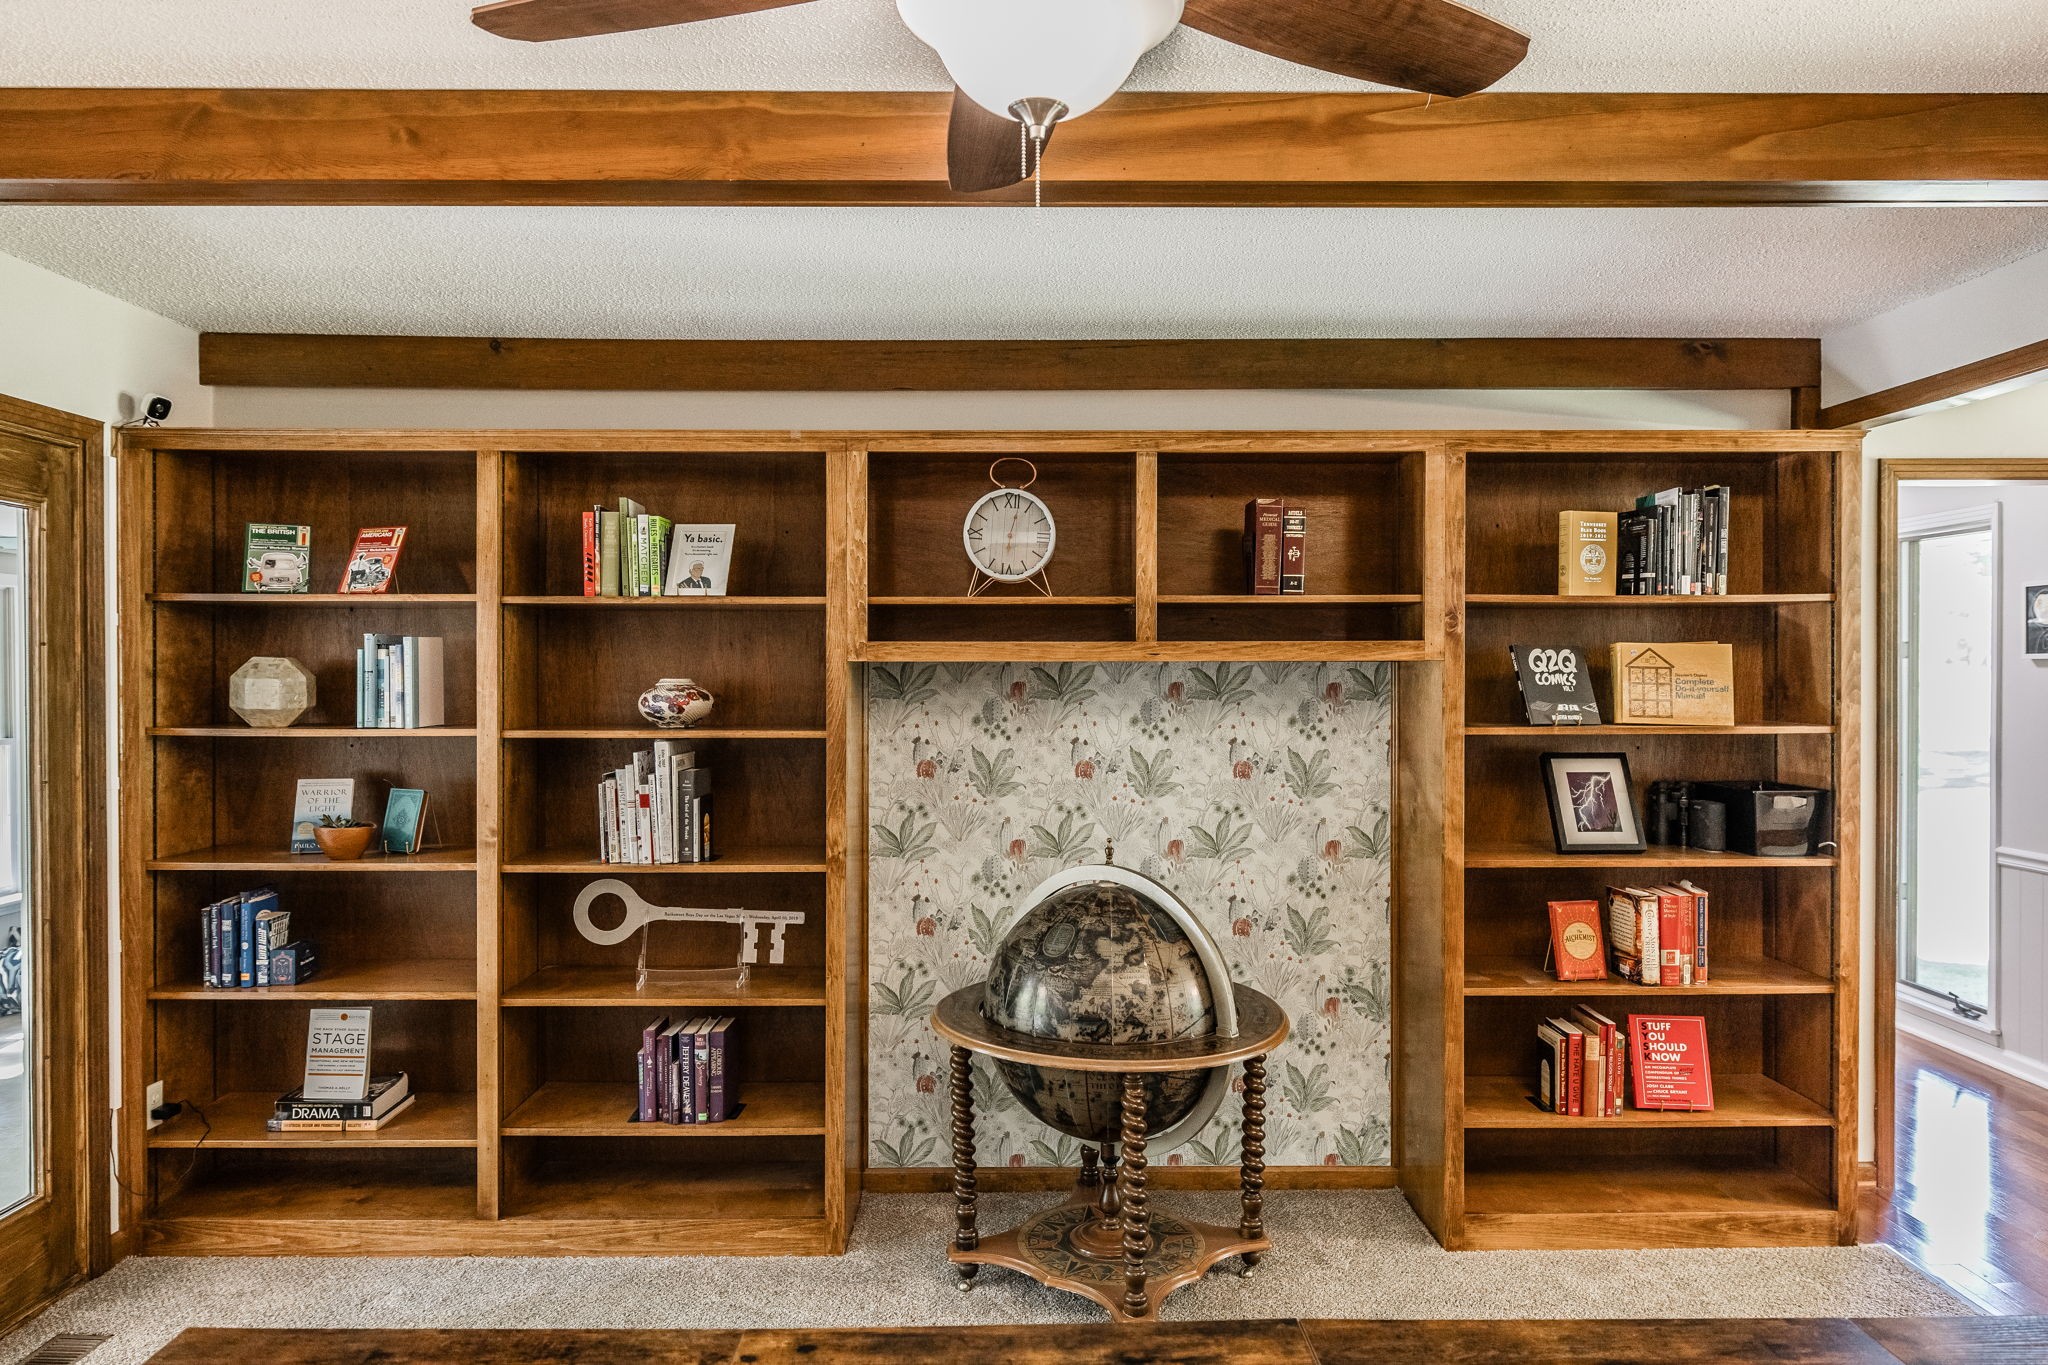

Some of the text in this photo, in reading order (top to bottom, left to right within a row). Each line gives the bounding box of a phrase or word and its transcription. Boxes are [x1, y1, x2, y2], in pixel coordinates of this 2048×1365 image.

[1004, 492, 1020, 509] XII
[684, 533, 723, 543] Ya basic.
[1528, 648, 1577, 673] Q2Q
[1535, 673, 1577, 686] COMICS
[1675, 677, 1715, 686] Complete
[1675, 685, 1729, 693] Do-it-yourself
[301, 788, 348, 796] WARRIOR
[323, 796, 341, 804] THE
[309, 805, 336, 813] LIGHT
[1564, 934, 1595, 943] ALCHEMIST
[1641, 1022, 1671, 1031] STUFF
[312, 1032, 366, 1045] STAGE
[1642, 1032, 1665, 1041] YOU
[1643, 1042, 1687, 1052] SHOULD
[1644, 1052, 1681, 1062] KNOW
[292, 1108, 340, 1119] DRAMA
